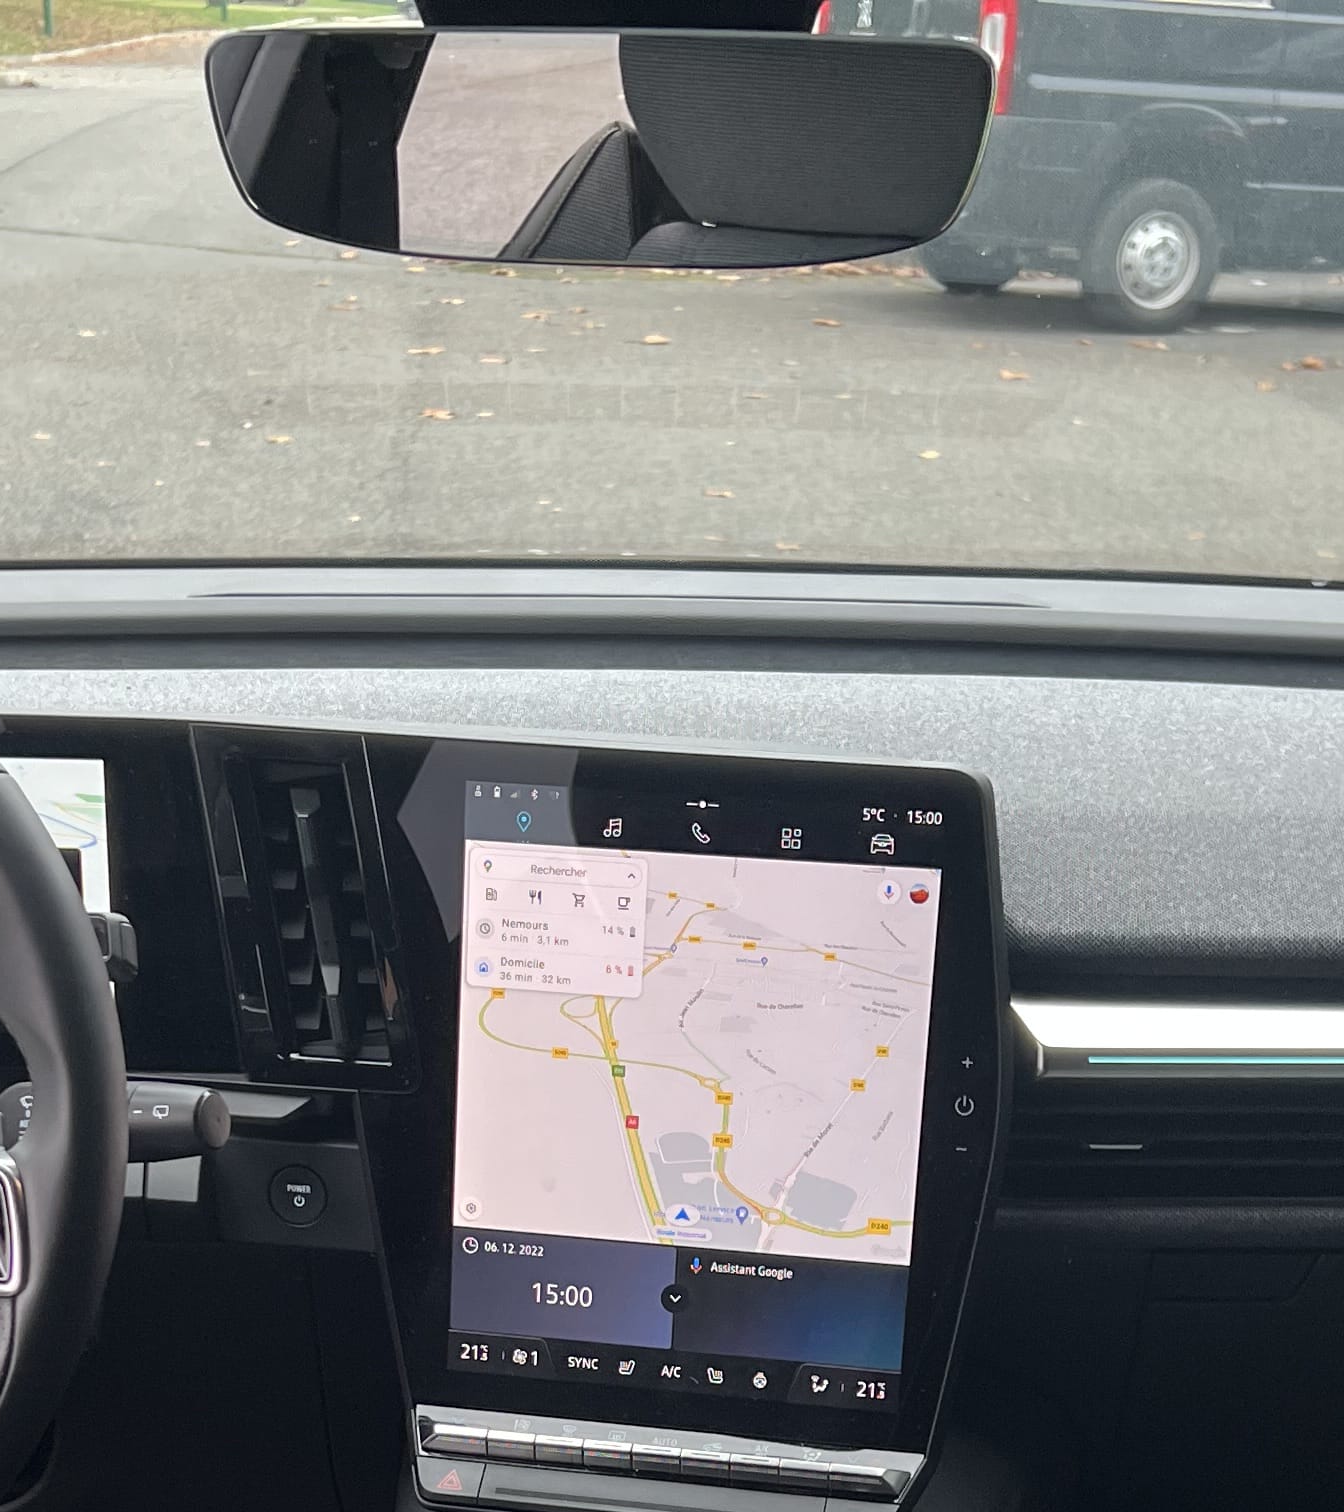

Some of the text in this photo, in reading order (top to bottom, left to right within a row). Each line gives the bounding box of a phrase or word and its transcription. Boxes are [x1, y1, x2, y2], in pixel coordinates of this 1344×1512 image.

[907, 810, 943, 825] 15:00
[530, 864, 587, 878] Rechercher
[501, 918, 549, 931] Nemours
[602, 926, 613, 934] 14
[501, 933, 507, 942] 6
[510, 933, 528, 943] min
[555, 937, 569, 946] km
[501, 957, 545, 969] Domicile
[500, 972, 571, 985] 36 min 32 km
[710, 1261, 793, 1281] Assistant Google
[531, 1282, 594, 1308] 15:00
[567, 1356, 599, 1370] SYNC
[660, 1365, 681, 1379] A/C
[651, 1437, 678, 1447] AUTO
